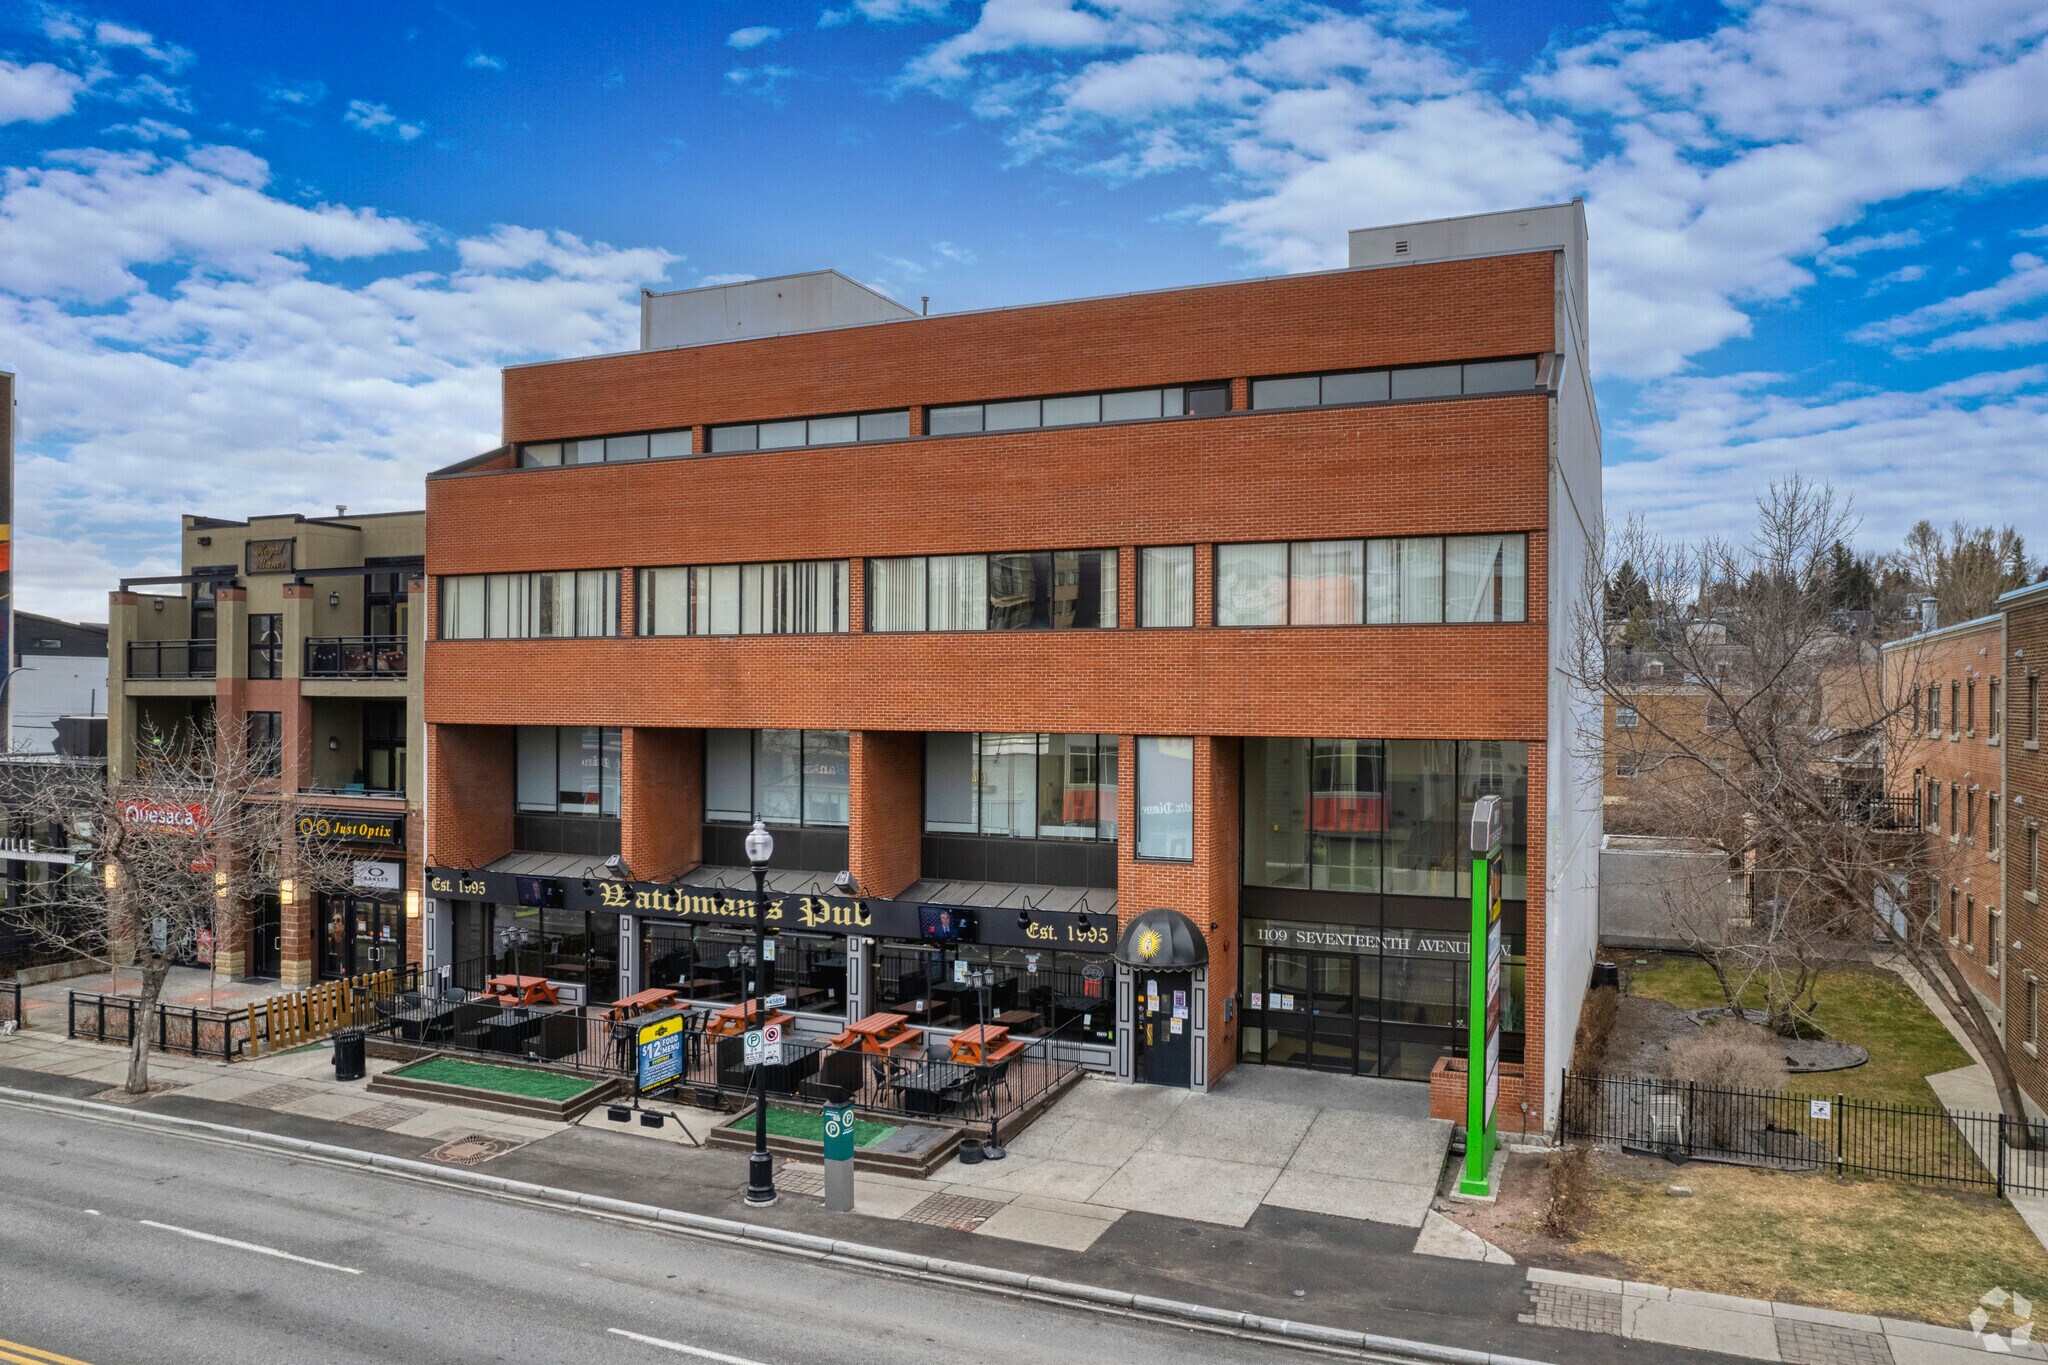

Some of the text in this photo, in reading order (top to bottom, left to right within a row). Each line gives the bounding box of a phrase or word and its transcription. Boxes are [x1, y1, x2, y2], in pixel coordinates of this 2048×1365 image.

[256, 542, 286, 560] Royal
[333, 822, 392, 839] Just Optix
[431, 877, 486, 895] Est. 1995
[797, 897, 872, 927] Pub
[1026, 922, 1108, 944] Est. 1995
[1257, 928, 1288, 943] 1109
[1296, 931, 1409, 950] SEVENTEENTH
[1083, 968, 1103, 977] OPEN
[642, 1034, 679, 1060] $12 FOOD
[662, 1042, 680, 1054] MENU
